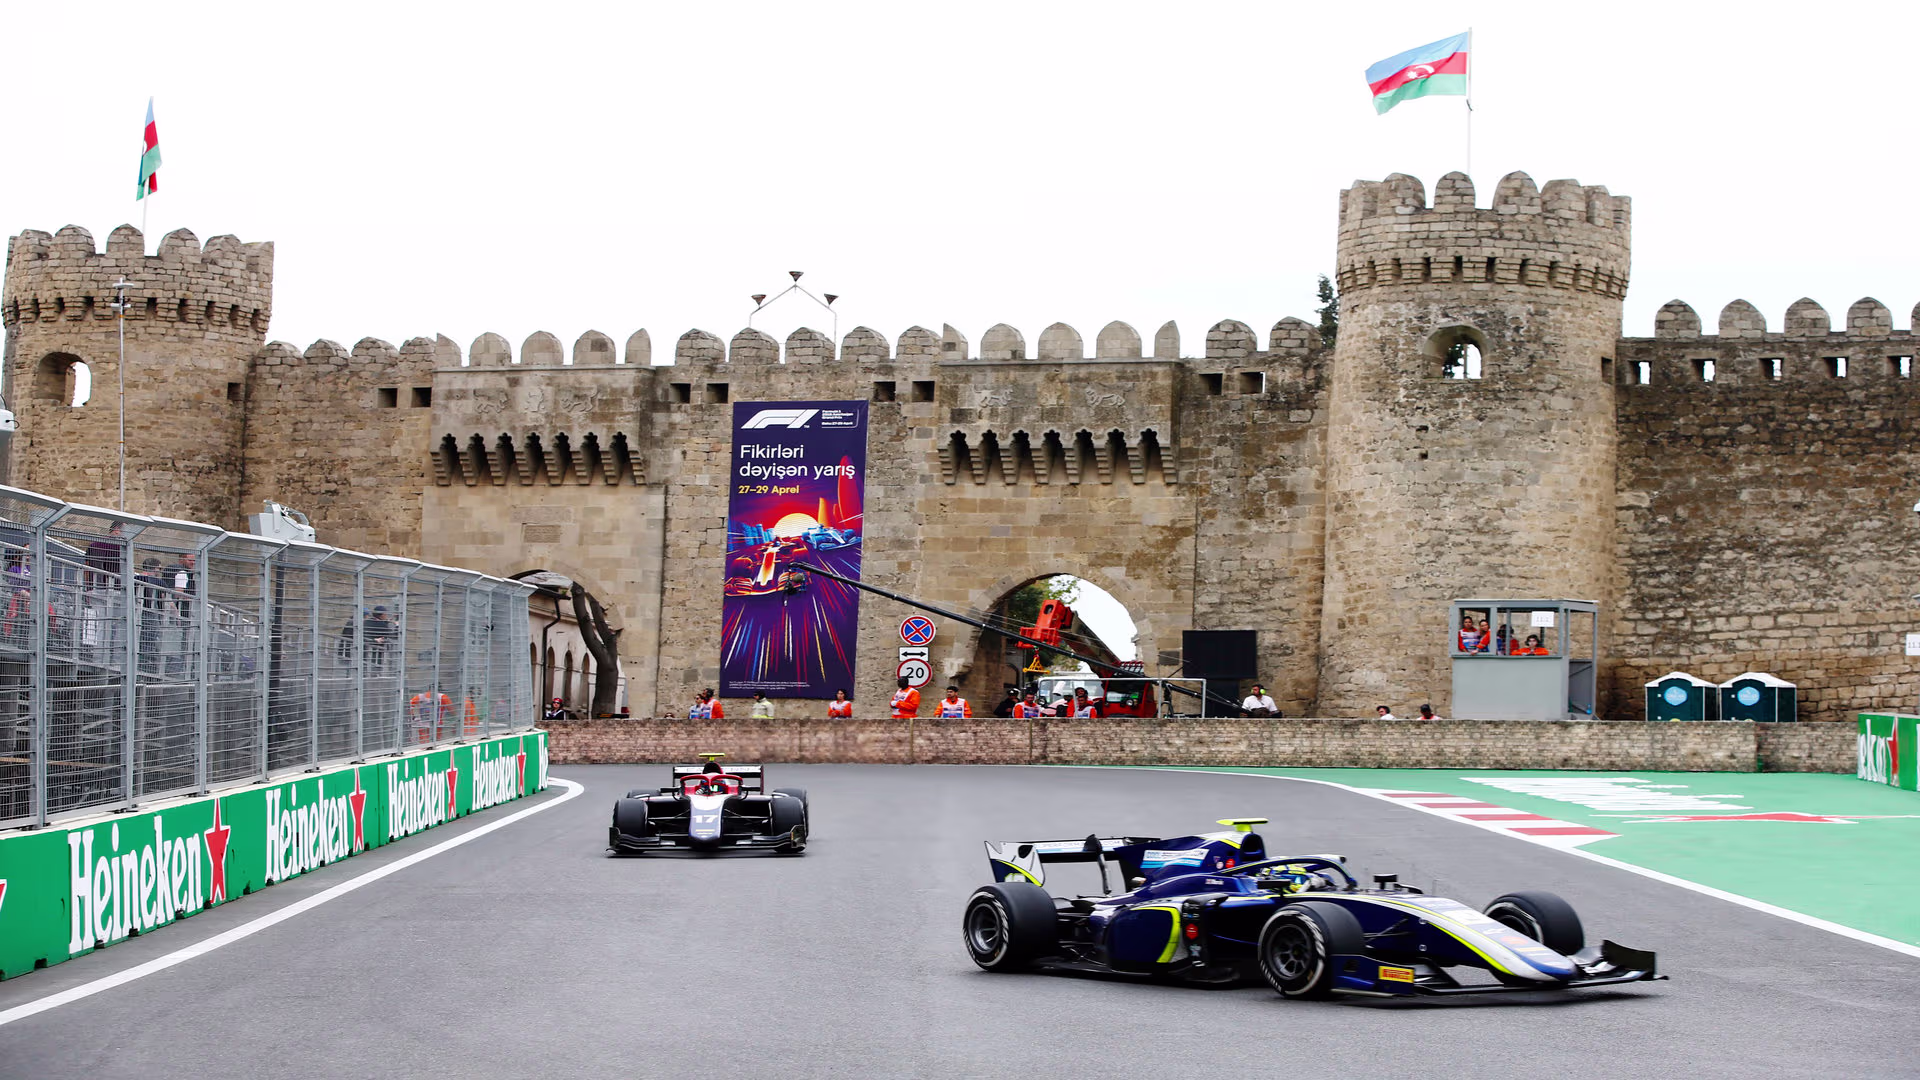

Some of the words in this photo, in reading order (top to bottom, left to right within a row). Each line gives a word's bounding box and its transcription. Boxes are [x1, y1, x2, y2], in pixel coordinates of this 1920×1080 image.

[740, 444, 804, 459] Fikirləri
[740, 462, 807, 480] dəyişən
[814, 465, 855, 480] yarış
[771, 485, 800, 496] Aprel
[906, 667, 924, 678] 20
[472, 742, 516, 811] Heineken
[388, 757, 446, 839] Heineken
[692, 815, 719, 824] 17
[265, 779, 349, 883] Heineken
[68, 815, 204, 954] Heineken
